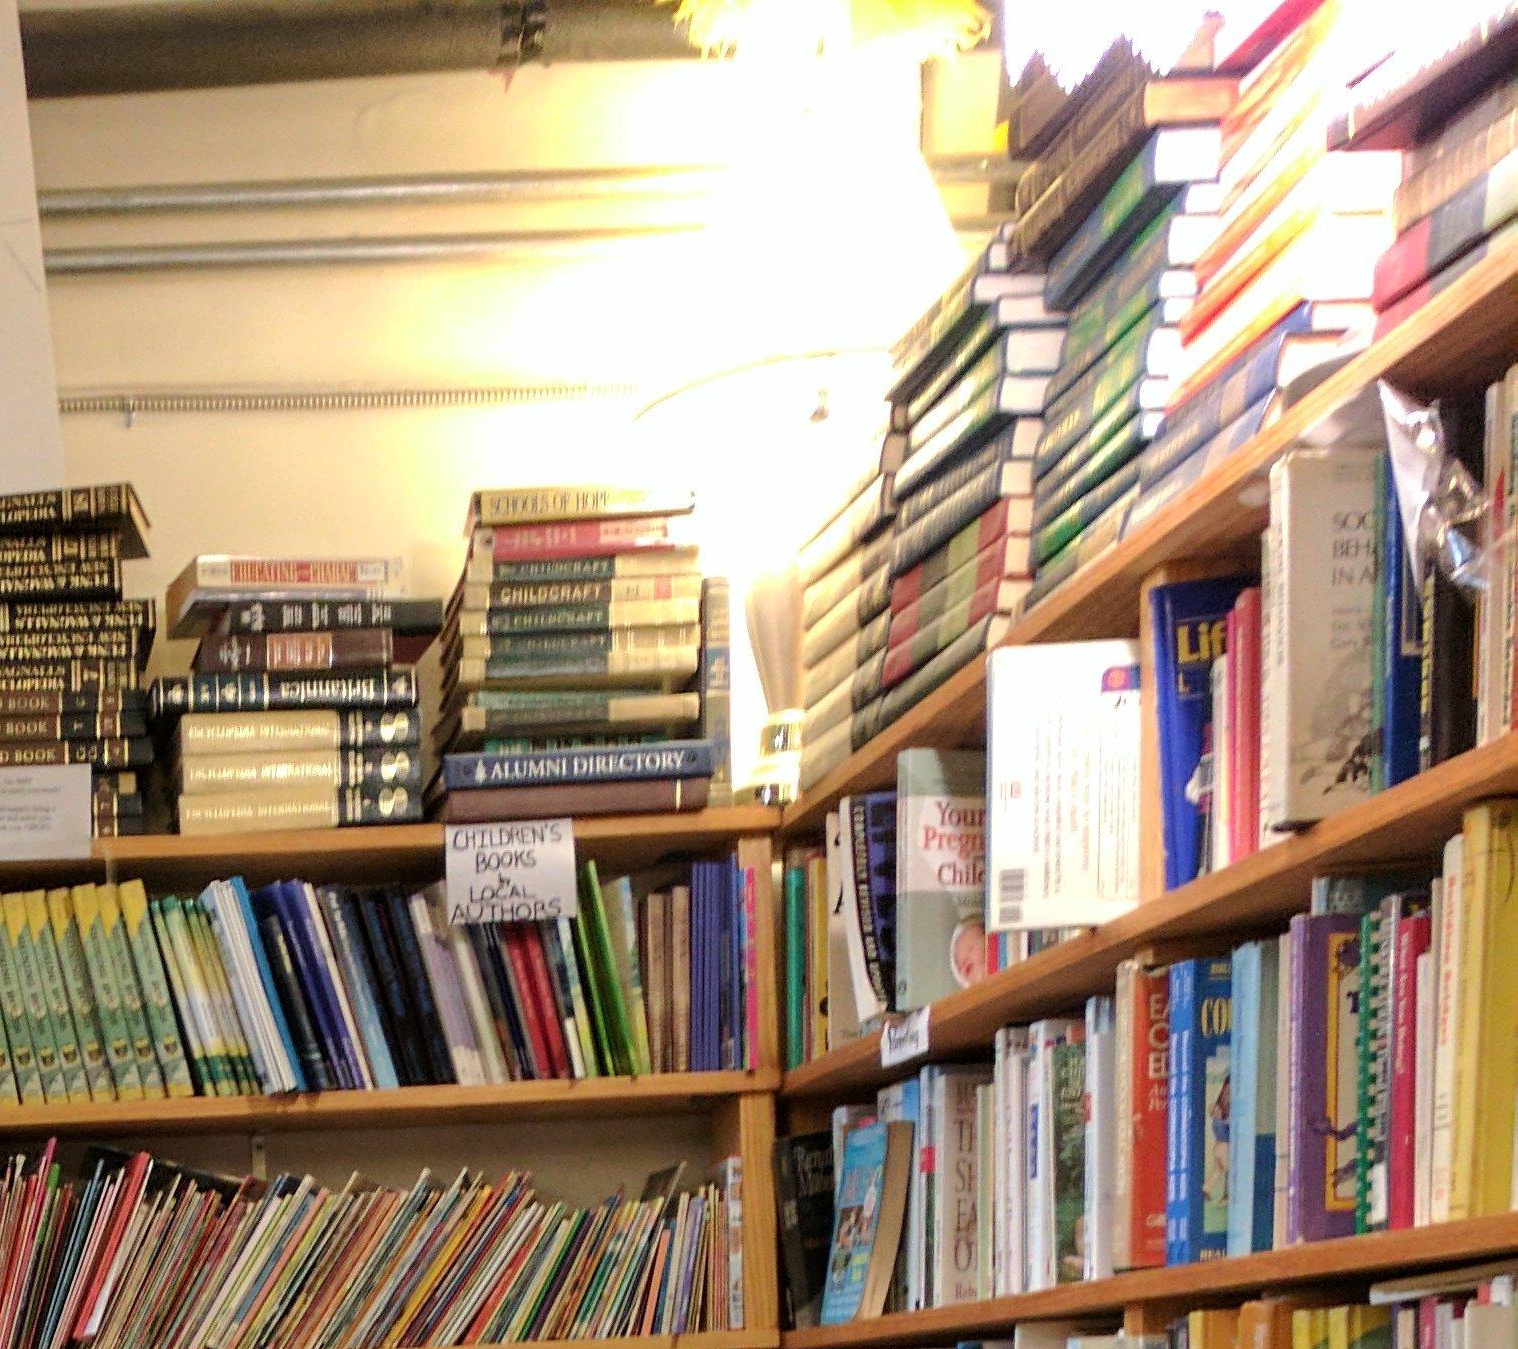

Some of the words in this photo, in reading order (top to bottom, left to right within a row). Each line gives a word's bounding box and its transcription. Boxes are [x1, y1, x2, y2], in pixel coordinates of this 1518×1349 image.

[281, 678, 375, 702] Britannica
[7, 696, 51, 710] BOOK
[5, 721, 49, 735] BOOK
[14, 749, 57, 763] BOOK
[490, 758, 568, 782] ALUMNI
[572, 749, 685, 778] DIRECTORY
[451, 822, 563, 851] CHILDREN'S
[475, 849, 538, 875] BOOKS
[468, 883, 537, 904] LOCAL
[450, 896, 562, 924] AUTHORS
